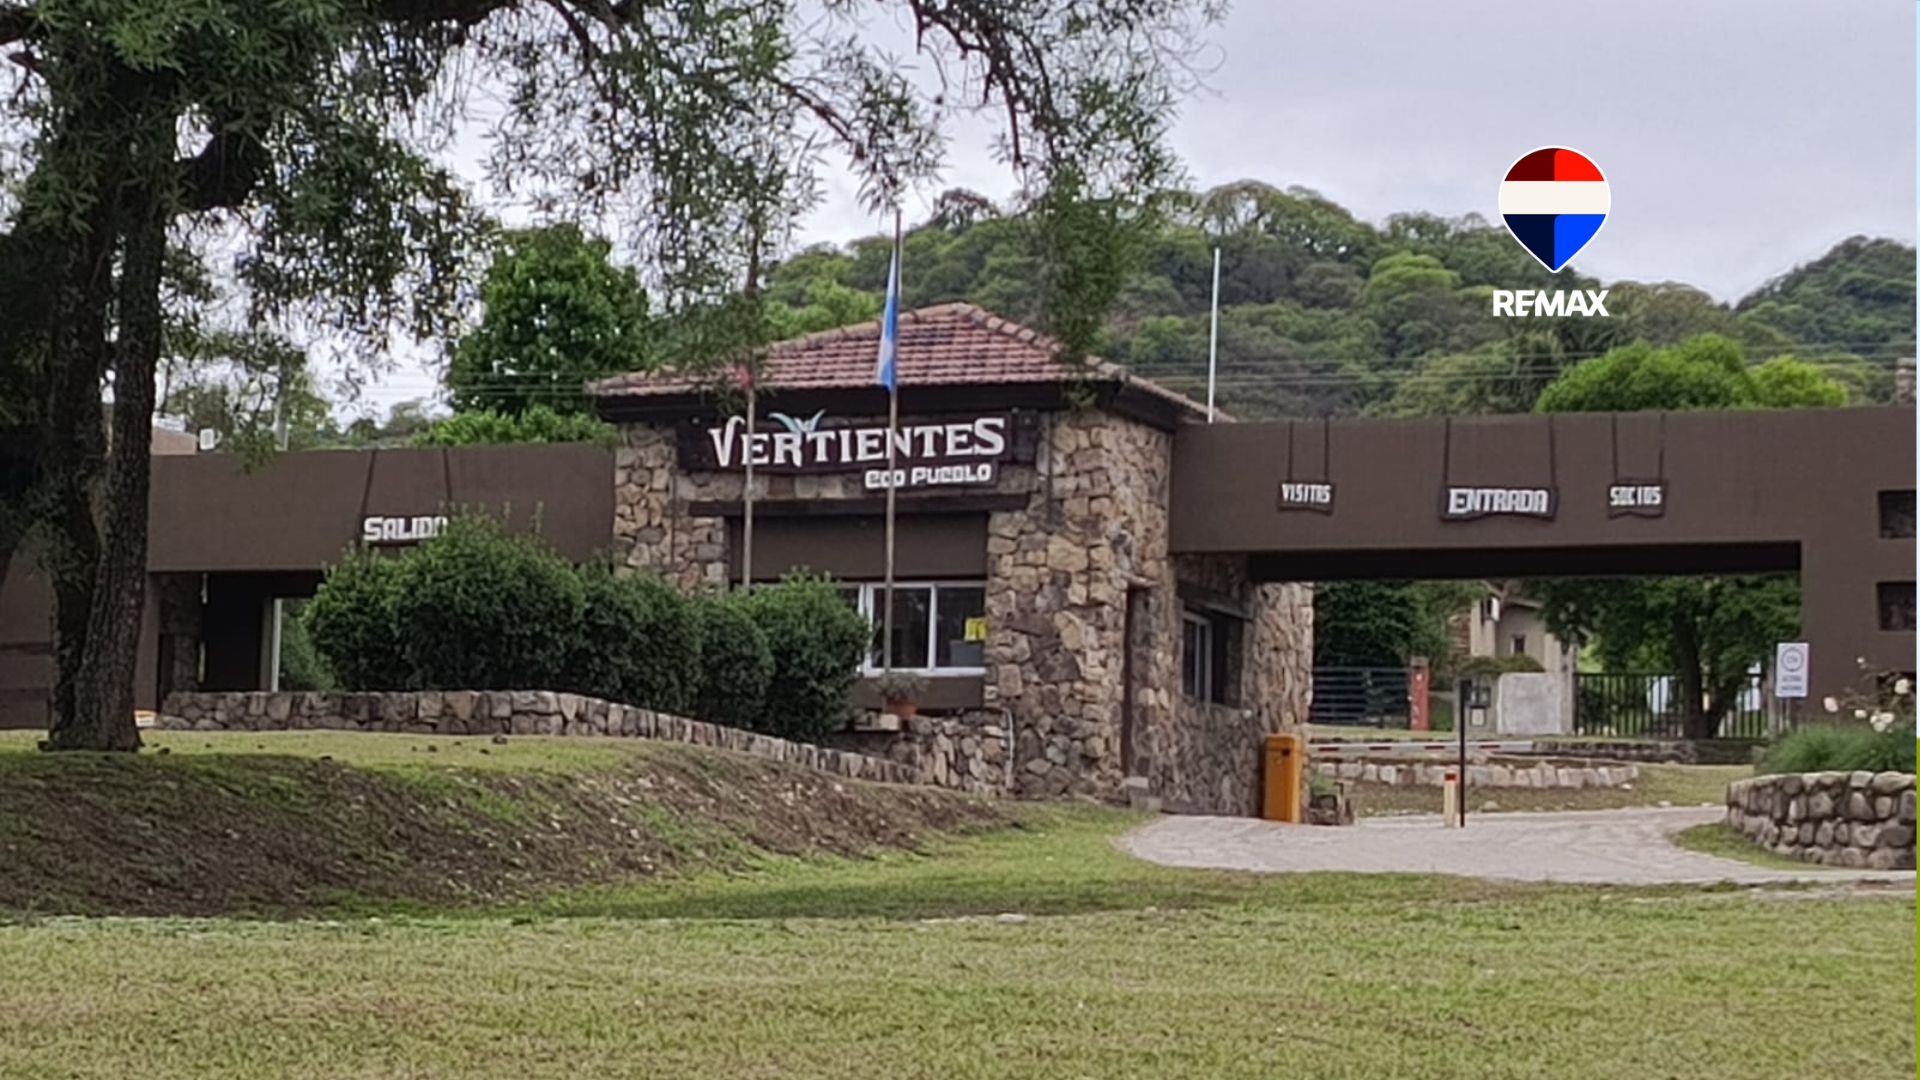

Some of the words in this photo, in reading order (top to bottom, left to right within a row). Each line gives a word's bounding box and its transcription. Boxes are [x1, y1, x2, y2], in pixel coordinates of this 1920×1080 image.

[1281, 483, 1331, 503] VISITAS
[1448, 488, 1548, 514] ENTRADA
[1610, 485, 1661, 506] SOCIOS
